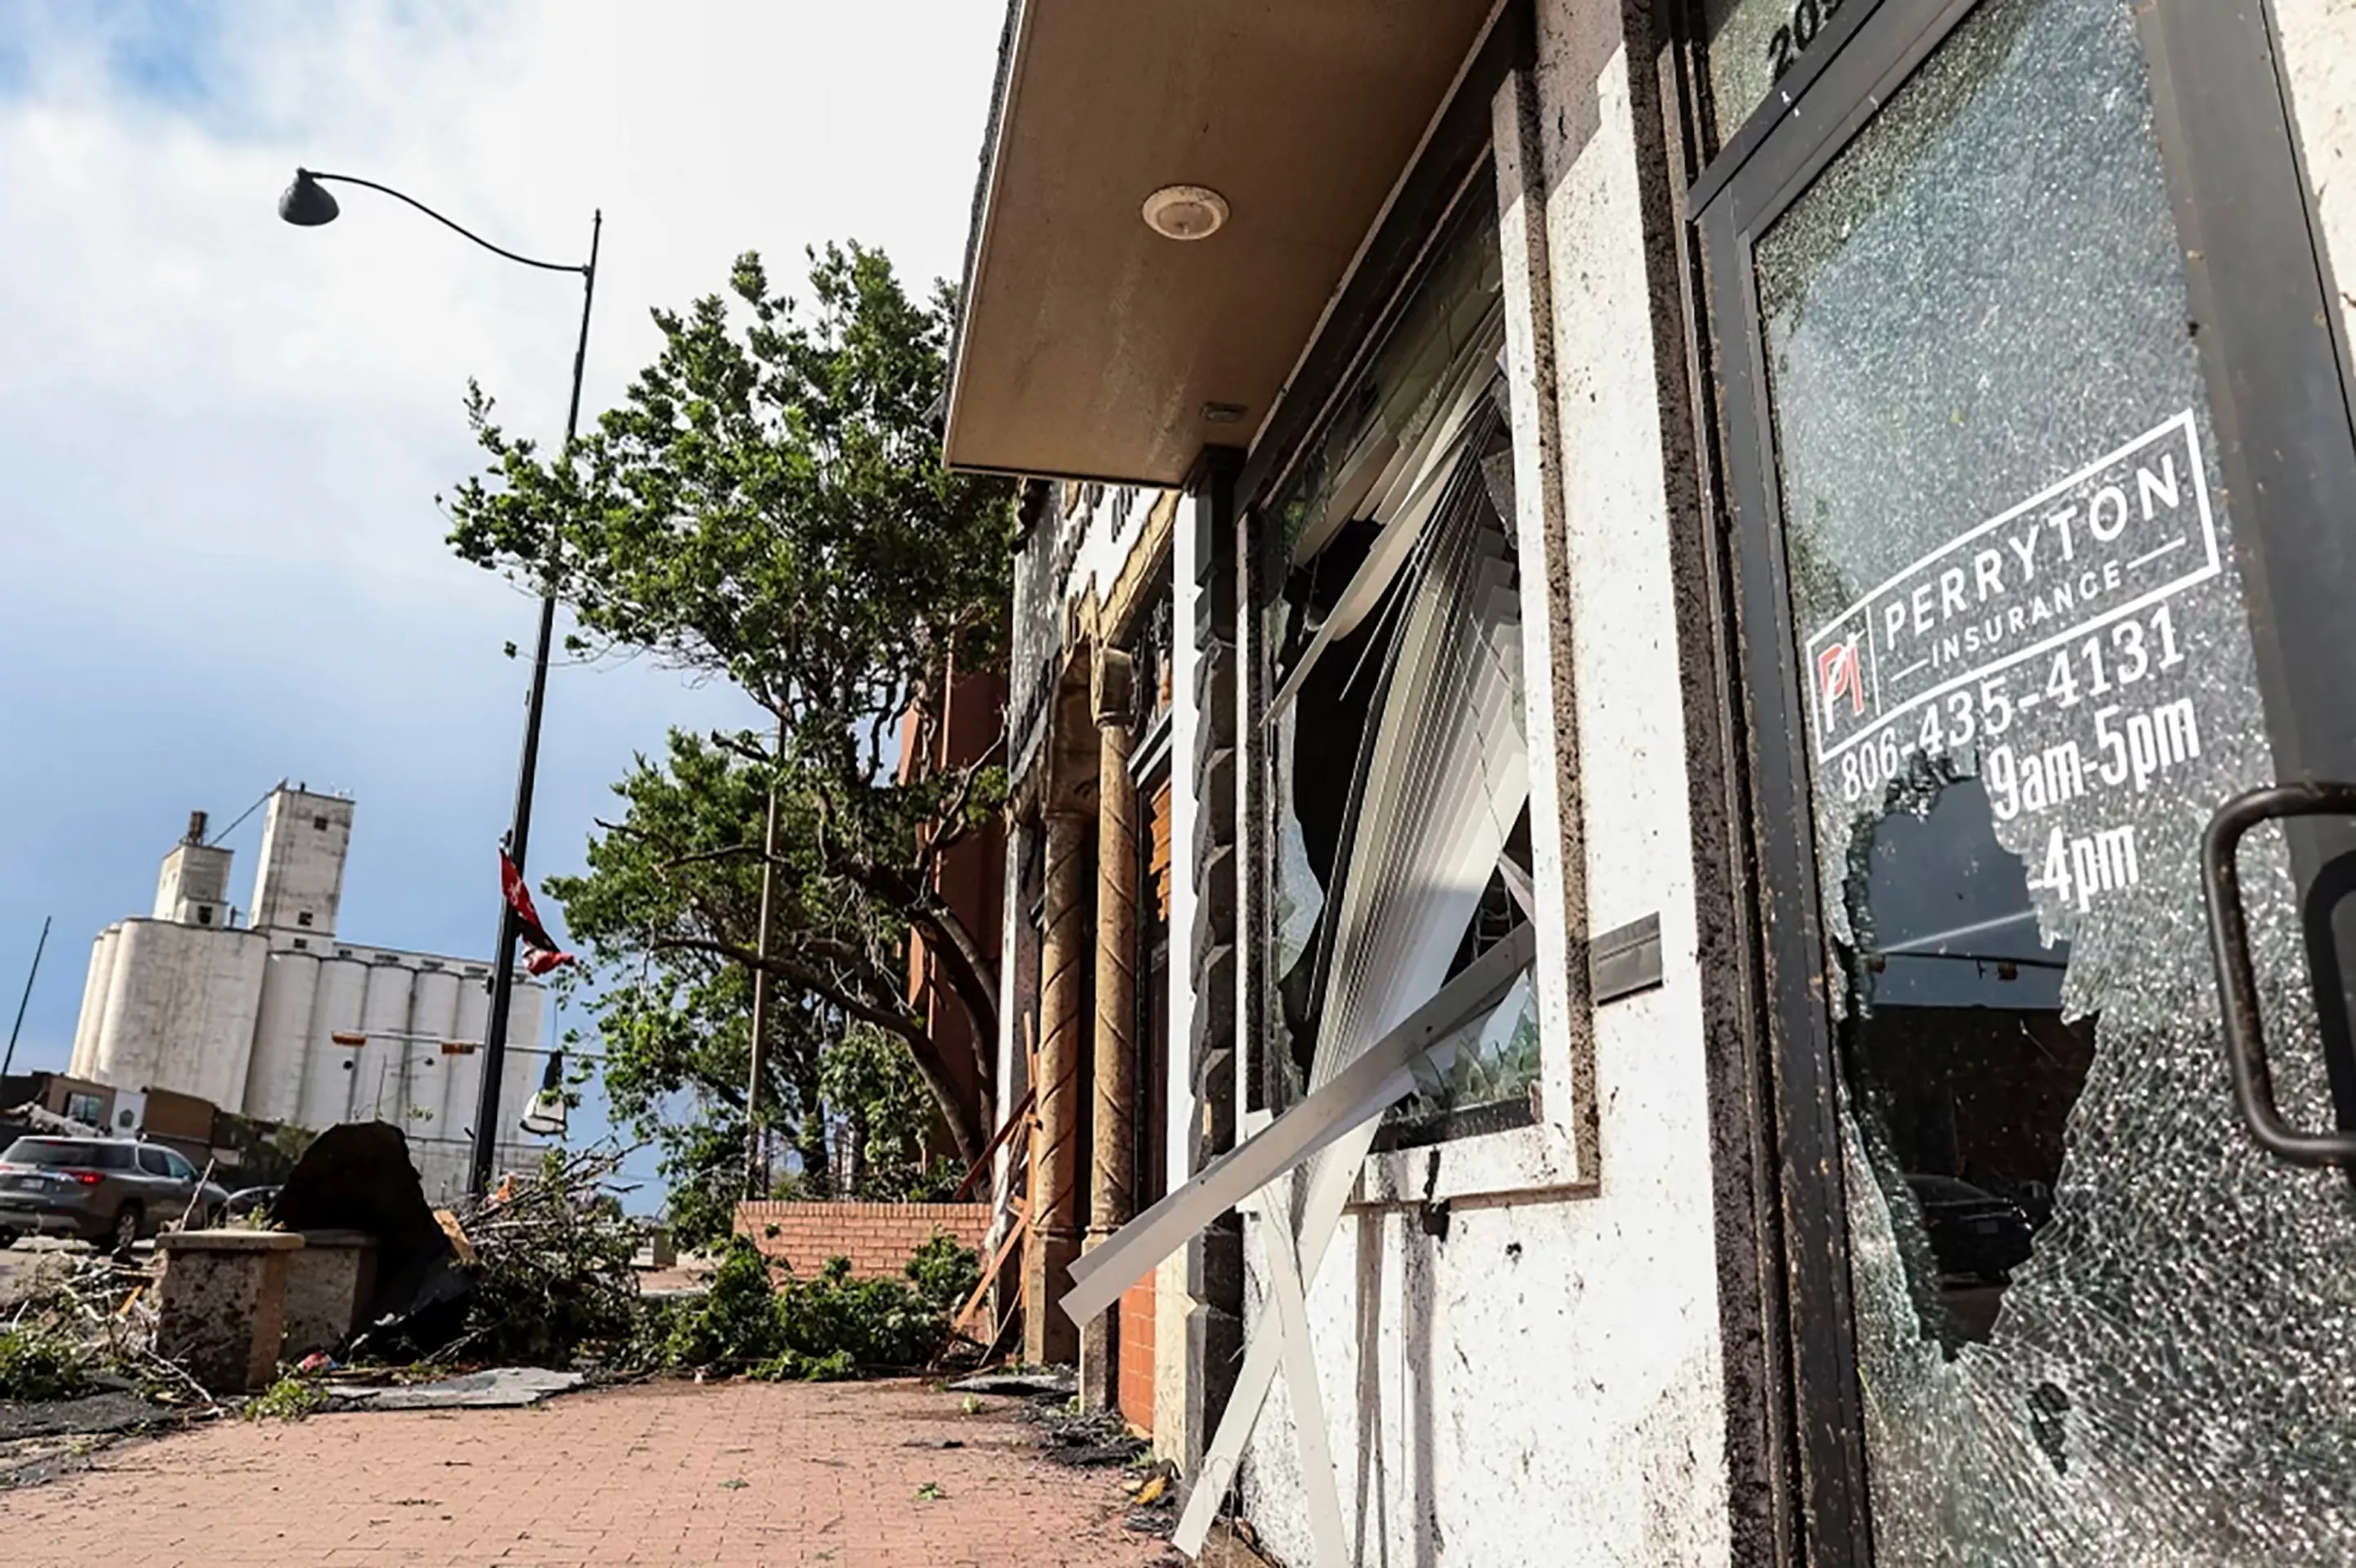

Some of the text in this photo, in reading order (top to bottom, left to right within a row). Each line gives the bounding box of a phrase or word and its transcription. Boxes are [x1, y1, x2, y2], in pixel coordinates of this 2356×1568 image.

[1768, 0, 1844, 86] 20
[1885, 452, 2180, 651] PERRYTON
[1932, 559, 2122, 668] INSURANCE
[1841, 603, 2184, 803] 806-435-4131
[1988, 697, 2201, 821] 9am-5pm
